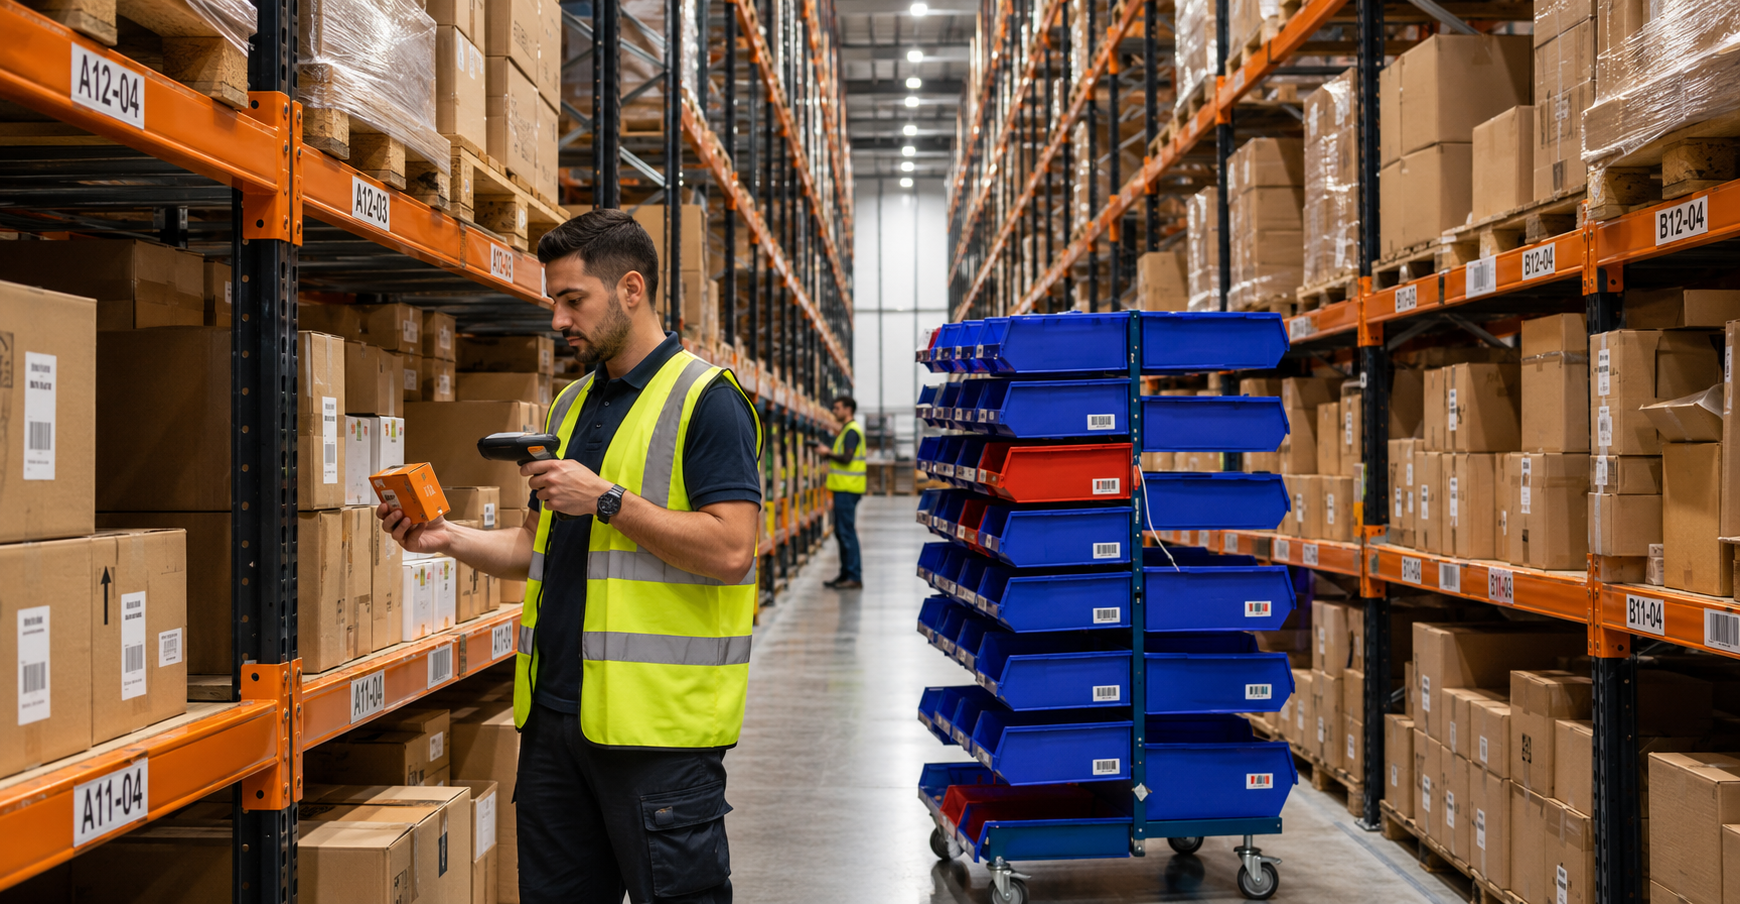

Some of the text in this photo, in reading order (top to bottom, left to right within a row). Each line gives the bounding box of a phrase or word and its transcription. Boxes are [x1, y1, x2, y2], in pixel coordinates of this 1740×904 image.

[78, 54, 139, 118] A12-04
[355, 183, 387, 223] A12-03
[1660, 201, 1704, 239] B12-04
[1525, 247, 1553, 275] B12-04
[1629, 598, 1662, 630] B11-04
[354, 675, 382, 716] A11-04
[82, 768, 142, 834] A11-04
